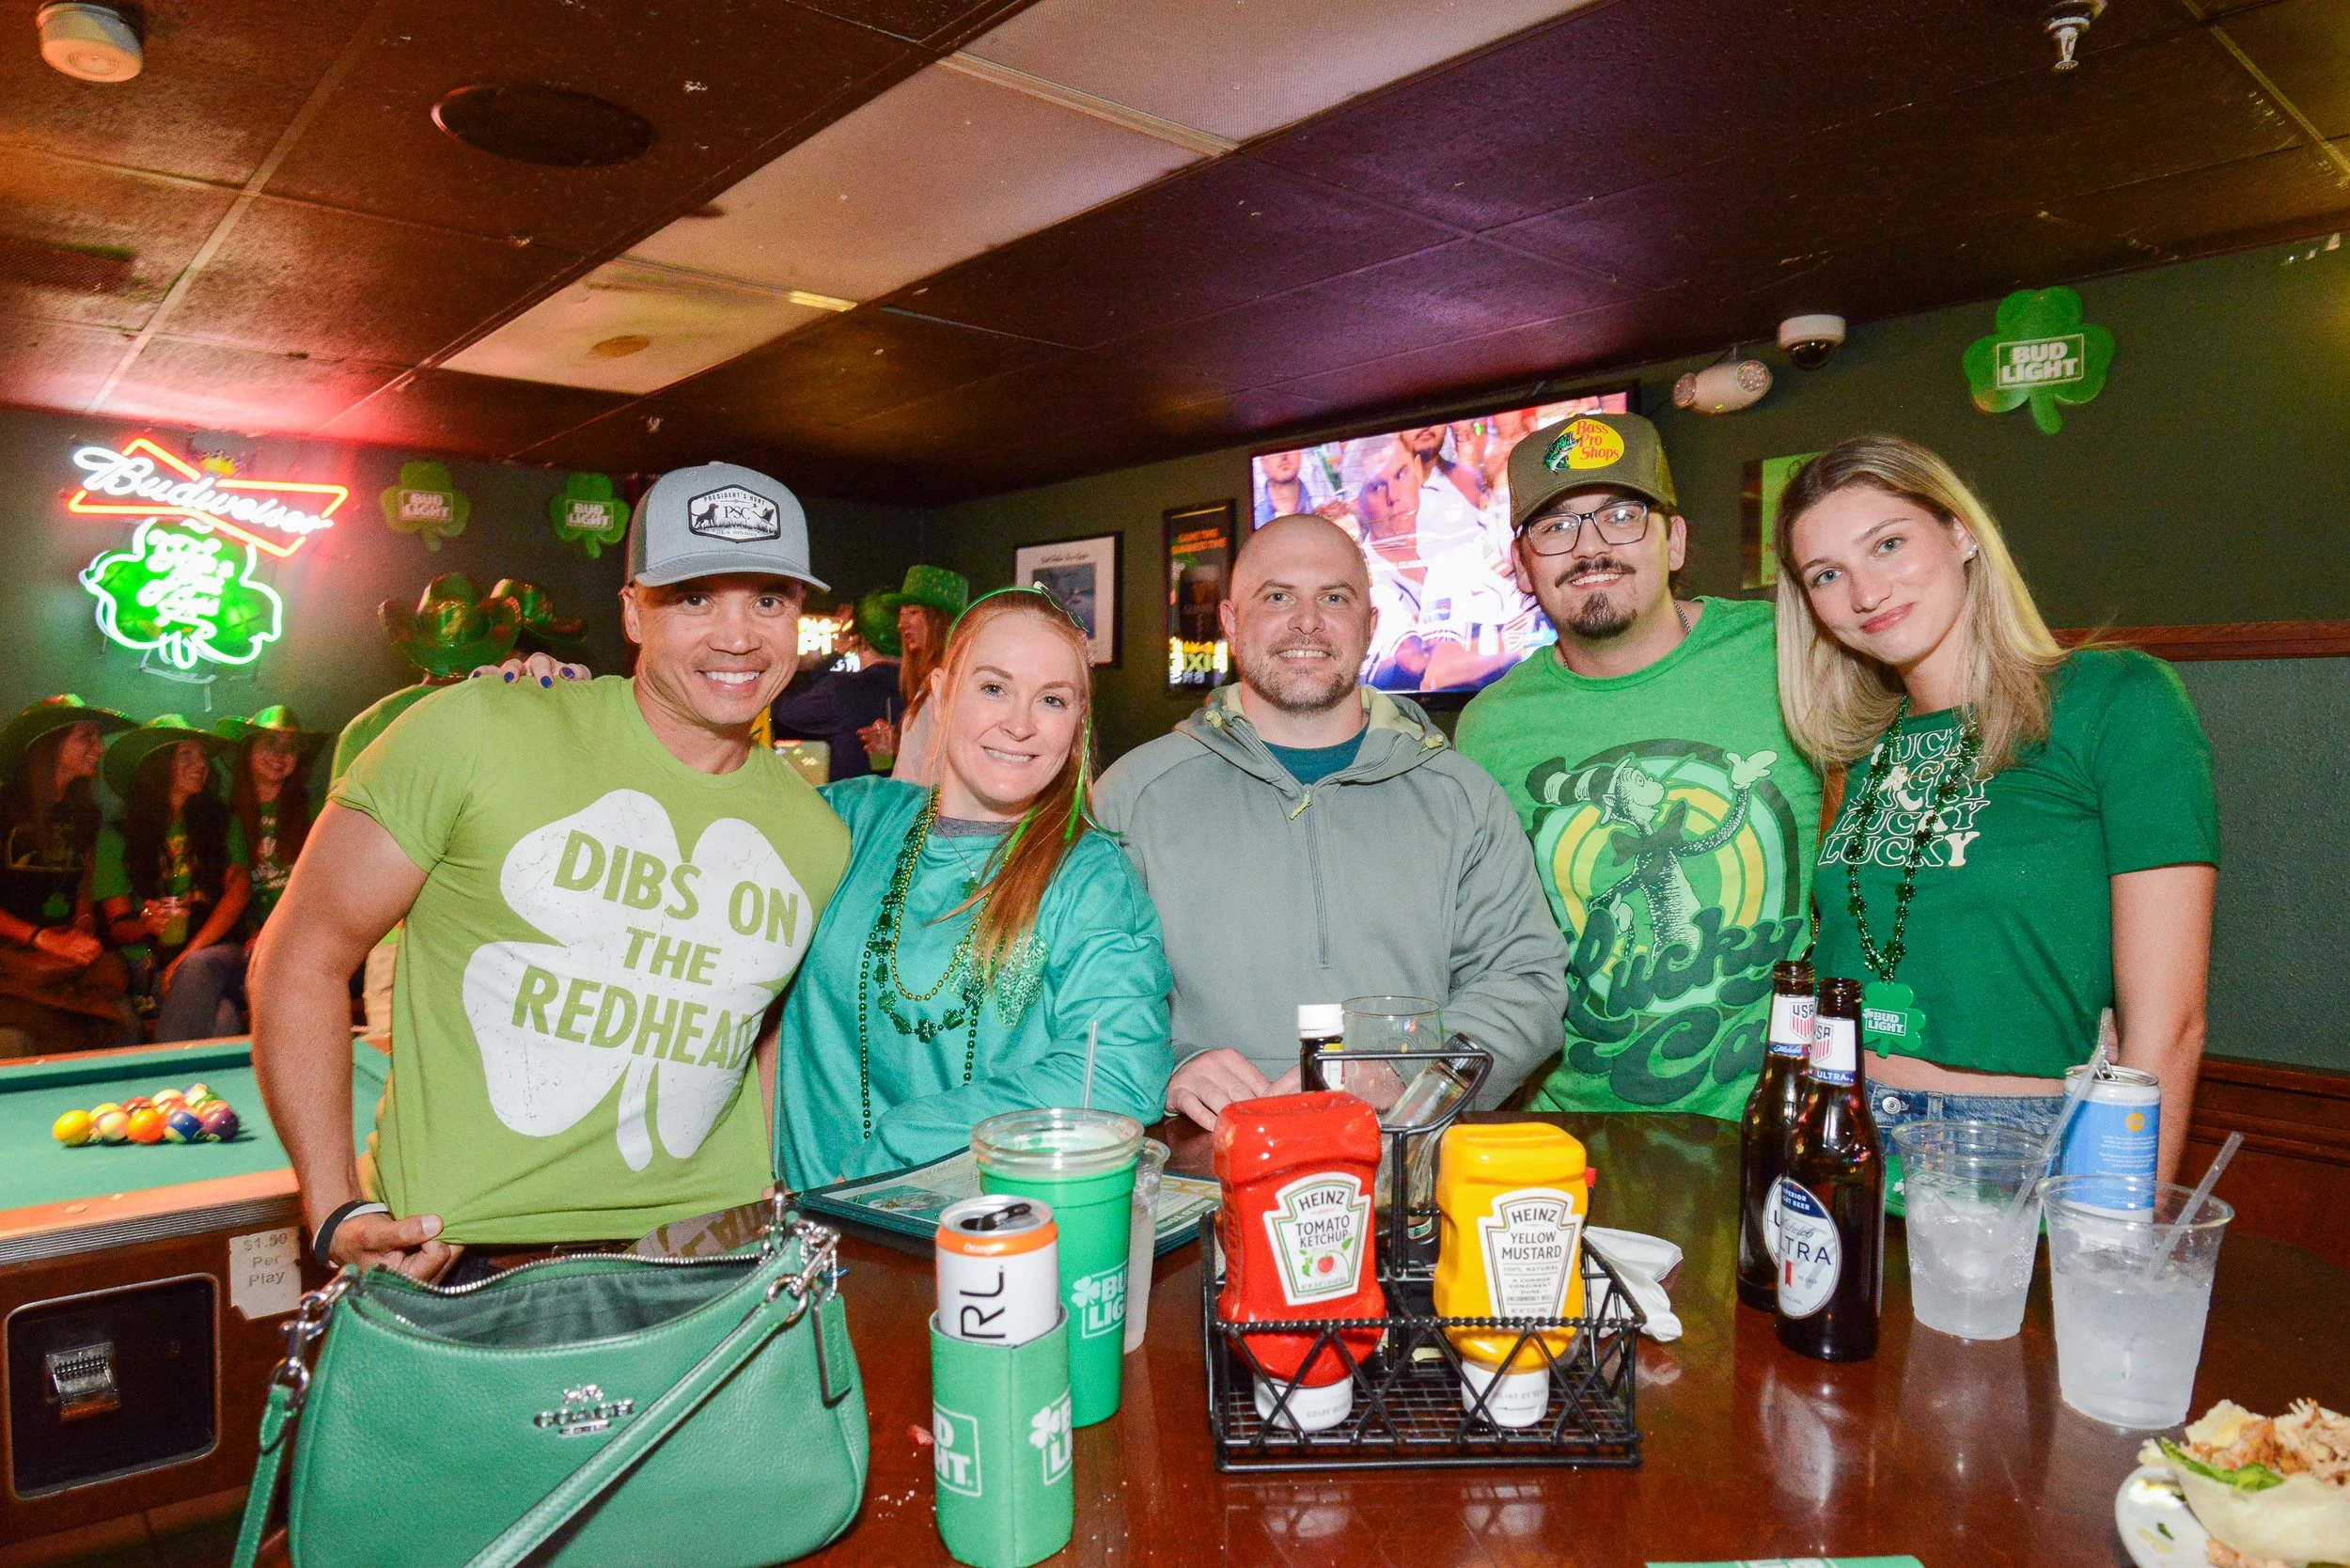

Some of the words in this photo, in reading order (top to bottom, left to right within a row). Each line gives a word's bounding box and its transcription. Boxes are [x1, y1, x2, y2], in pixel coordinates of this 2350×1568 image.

[2012, 341, 2068, 365] BUD
[2001, 357, 2078, 383] LIGHT
[1575, 420, 1608, 435] Bass
[1579, 433, 1603, 447] Pro
[1580, 446, 1620, 461] Shops
[72, 446, 335, 536] Budweiser
[703, 492, 746, 502] PRESIDENT'S
[409, 492, 444, 507] BUD
[402, 503, 451, 518] LIGHT
[573, 502, 604, 515] BUD
[723, 505, 751, 520] PSC
[567, 512, 611, 525] LIGHT
[1817, 831, 1981, 868] LUCKY
[553, 828, 703, 921] DIBS
[728, 880, 799, 949] ON
[623, 925, 722, 986] THE
[1872, 1011, 1900, 1024] BUD
[1814, 1025, 1831, 1041] SA
[1568, 1006, 1769, 1105] Ca
[1816, 1070, 1848, 1082] ULTRA
[1297, 1190, 1346, 1212] HEINZ
[1511, 1208, 1558, 1224] HEINZ
[1295, 1215, 1351, 1237] TOMATO
[243, 1232, 288, 1252] $1.50
[1299, 1229, 1349, 1248] KETCHUP
[1511, 1231, 1557, 1245] YELLOW
[1501, 1245, 1562, 1261] MUSTARD
[1779, 1235, 1832, 1265] LTRA
[252, 1255, 281, 1269] Per
[248, 1271, 286, 1287] Play
[1101, 1270, 1126, 1303] BU
[1089, 1294, 1125, 1330] LIG
[533, 1398, 634, 1428] COACH
